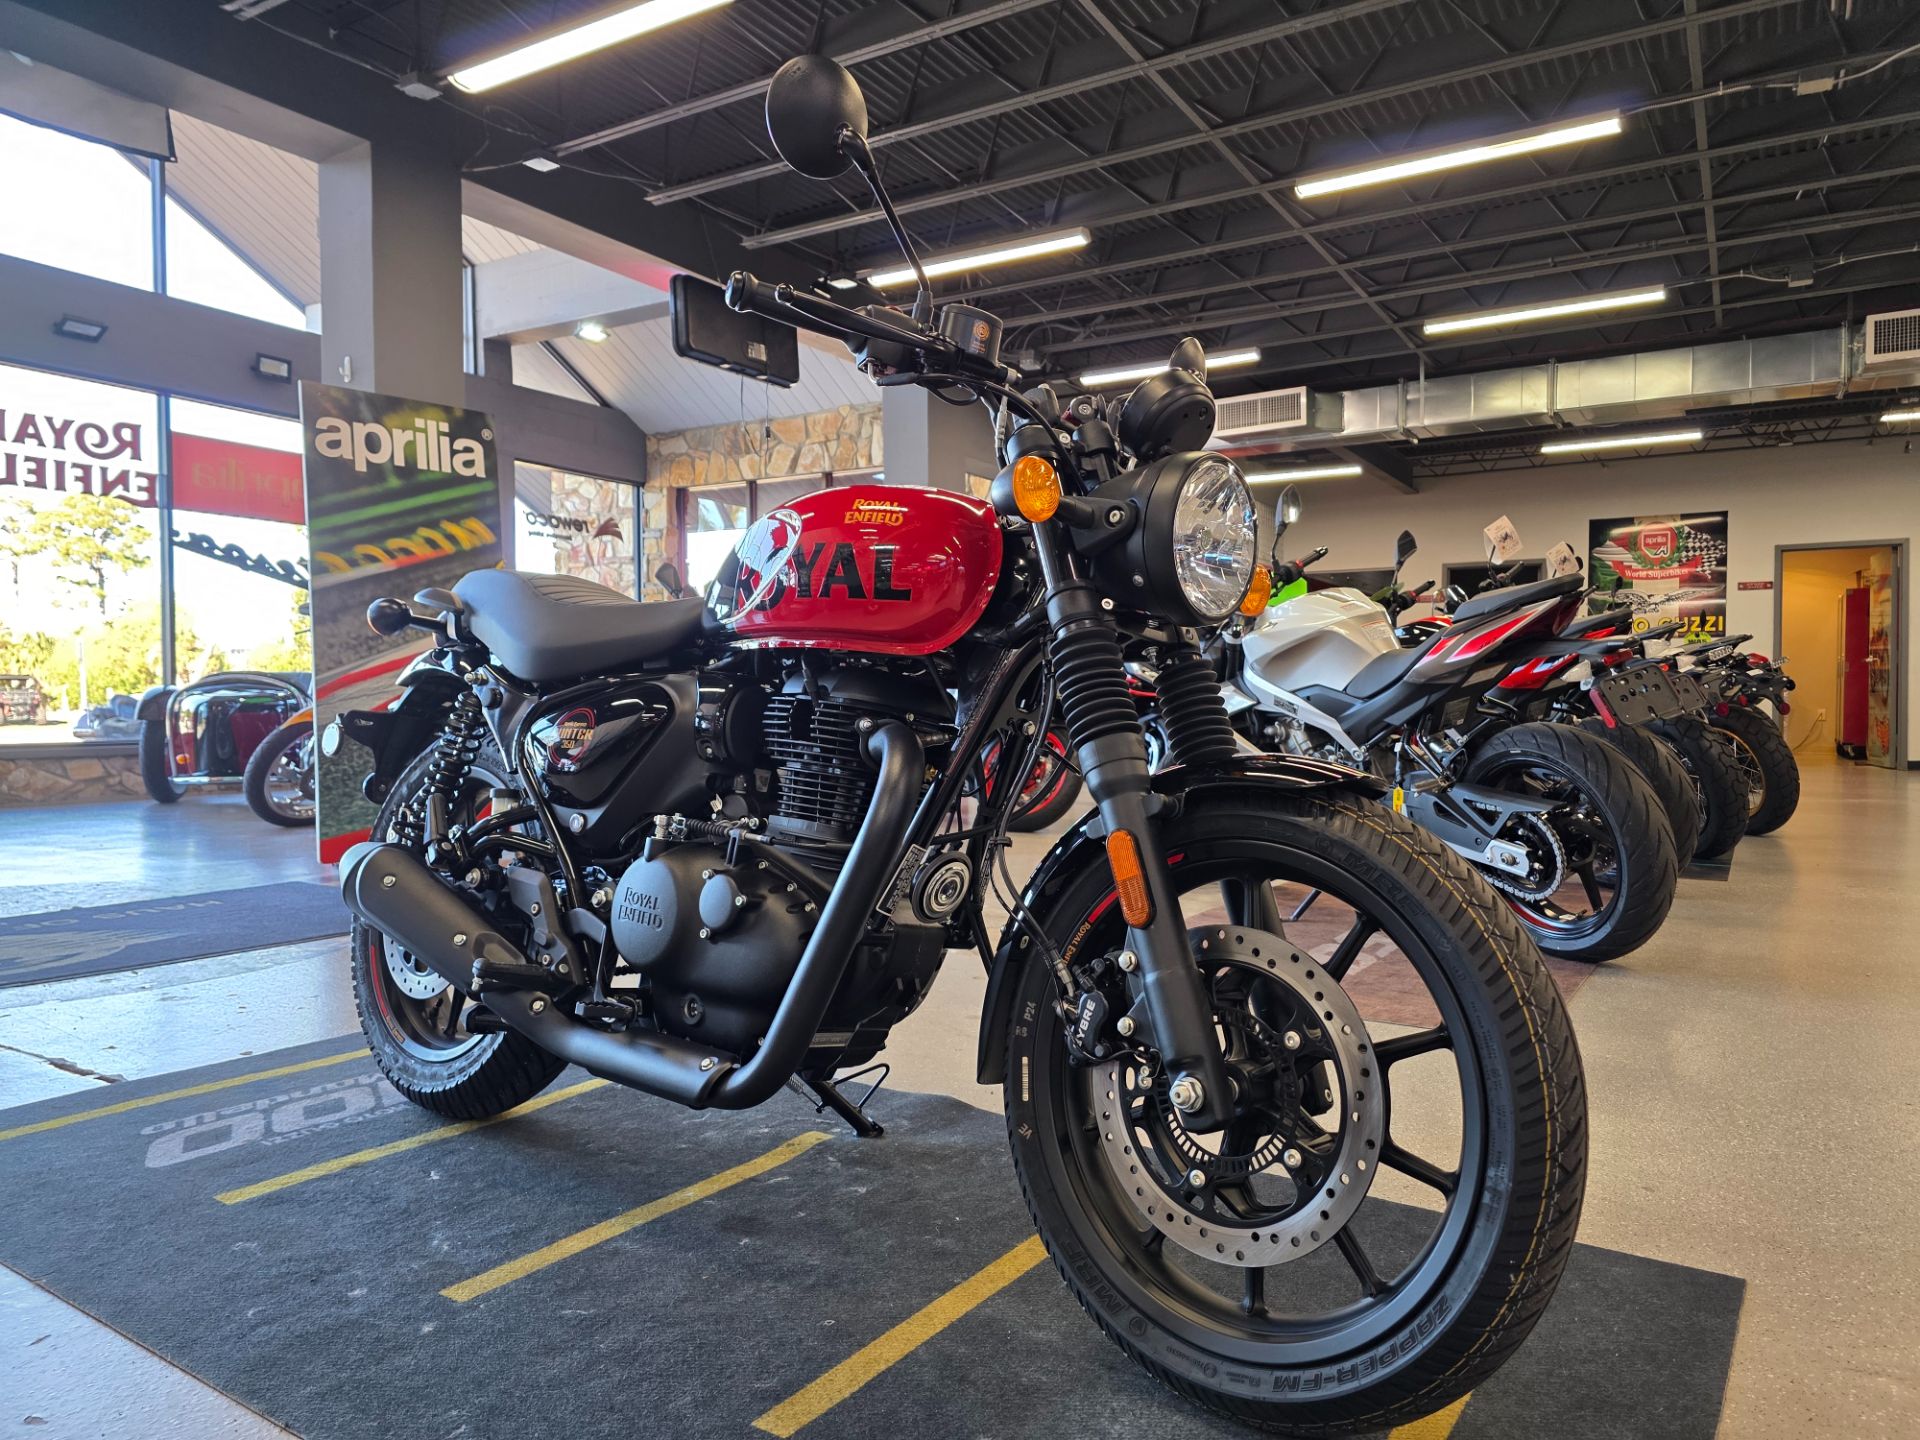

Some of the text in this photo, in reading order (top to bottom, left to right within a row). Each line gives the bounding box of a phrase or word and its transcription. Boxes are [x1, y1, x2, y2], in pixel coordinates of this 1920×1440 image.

[315, 416, 486, 478] aprilia
[844, 511, 904, 526] ENFIELD
[1625, 568, 1648, 578] World
[624, 886, 661, 910] ROYAL
[618, 904, 664, 931] ENFIELD
[1272, 1294, 1453, 1393] ZAPPER-FM
